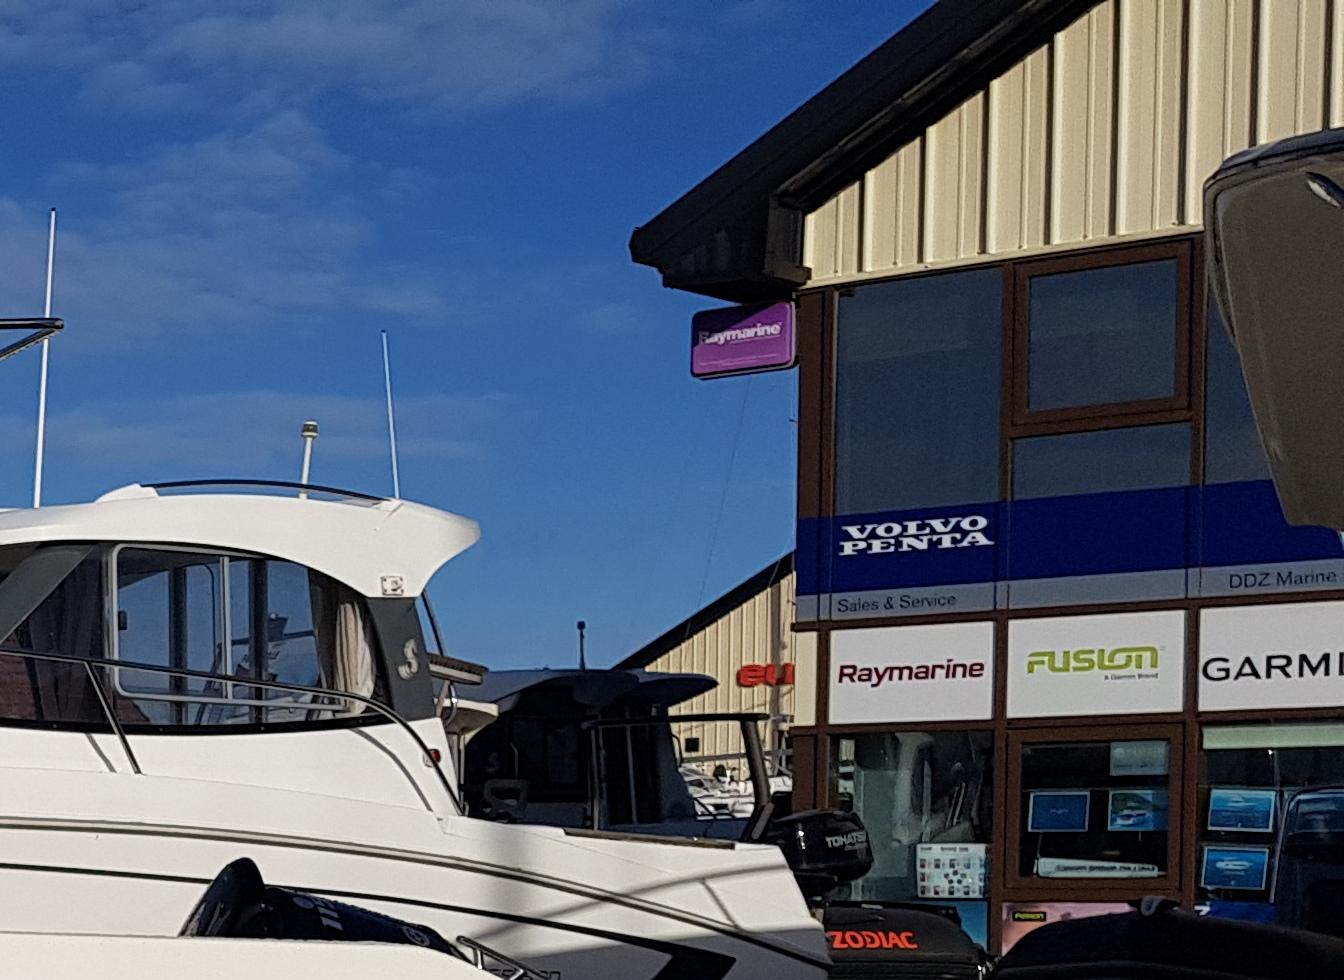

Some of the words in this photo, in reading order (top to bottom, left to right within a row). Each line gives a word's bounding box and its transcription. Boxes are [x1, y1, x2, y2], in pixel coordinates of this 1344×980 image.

[841, 515, 988, 540] VOLVO
[838, 531, 995, 556] PENTA
[1229, 572, 1271, 589] DDZ
[1276, 570, 1338, 587] Marine
[837, 597, 879, 613] Sales
[883, 596, 895, 611] &
[899, 592, 957, 610] Service
[838, 658, 985, 687] Raymarine
[827, 931, 919, 950] ZODIAC
